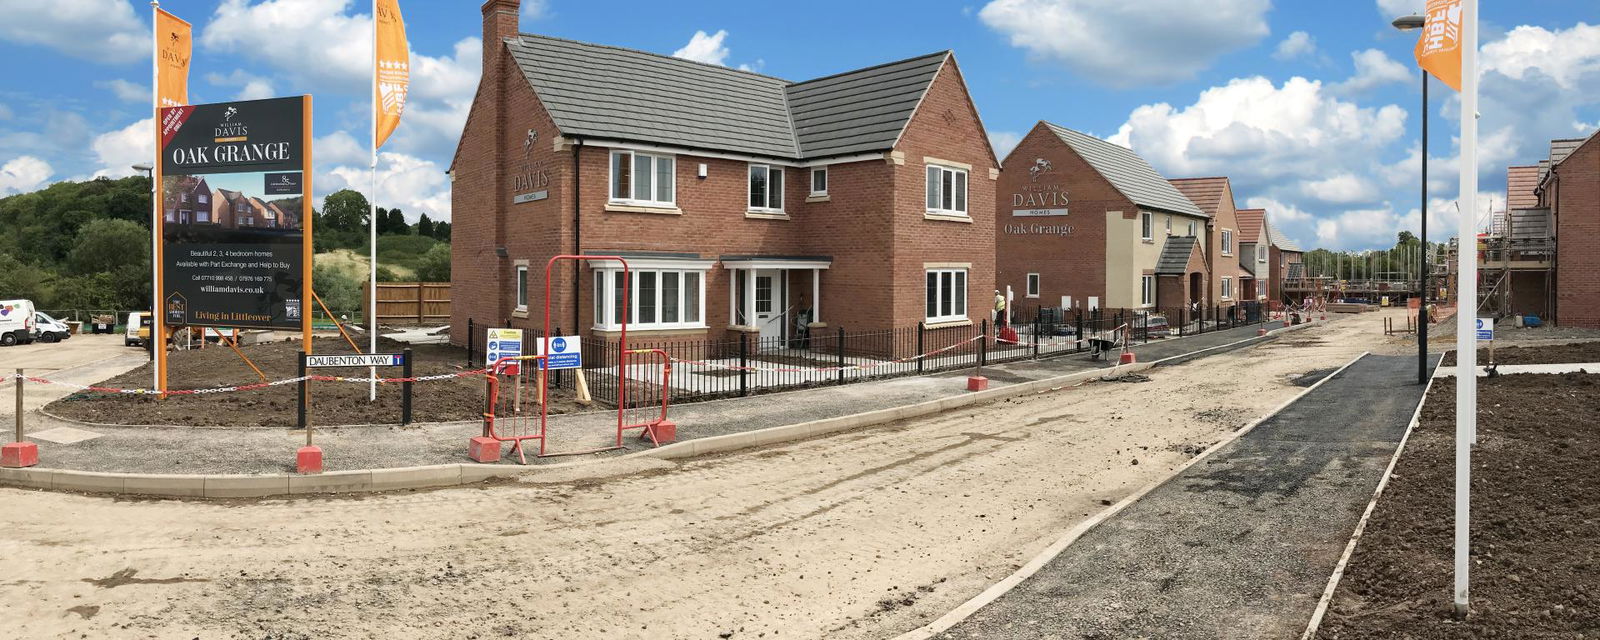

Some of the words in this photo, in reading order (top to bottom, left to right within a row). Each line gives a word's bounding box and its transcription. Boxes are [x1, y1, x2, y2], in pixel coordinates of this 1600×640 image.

[1429, 9, 1445, 49] HBF
[215, 126, 248, 137] DAVIS
[173, 147, 209, 165] OAK
[214, 142, 290, 163] GRANGE
[514, 170, 549, 192] DAVIS
[1012, 191, 1069, 207] DAVIS
[1004, 223, 1027, 234] Oak
[1030, 223, 1075, 237] Grange
[221, 261, 247, 269] Exchange
[260, 261, 272, 270] Help
[280, 261, 290, 270] Buy
[200, 285, 264, 294] williamdavis.co.uk
[195, 311, 219, 321] Living
[221, 311, 229, 320] in
[231, 312, 272, 321] Littleover
[309, 356, 366, 366] DAUBENTON
[369, 356, 390, 365] WAY
